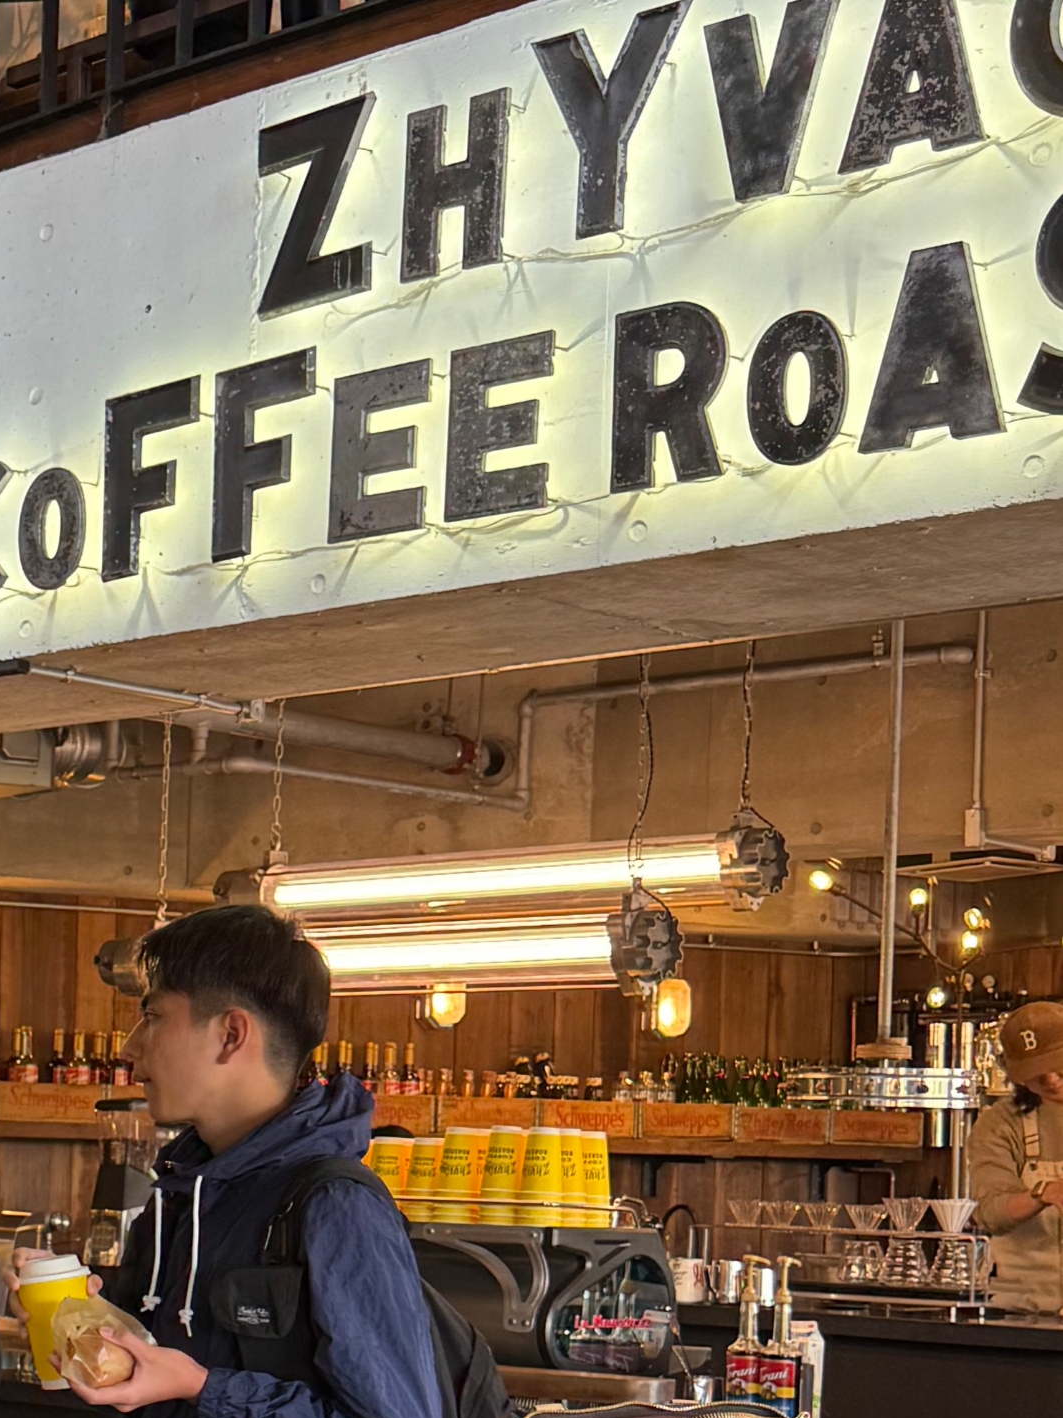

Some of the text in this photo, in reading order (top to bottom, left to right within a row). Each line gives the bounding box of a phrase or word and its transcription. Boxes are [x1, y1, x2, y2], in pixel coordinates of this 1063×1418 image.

[1019, 1030, 1037, 1050] B
[555, 1102, 625, 1130] Schweppes
[650, 1104, 720, 1133] Schweppes
